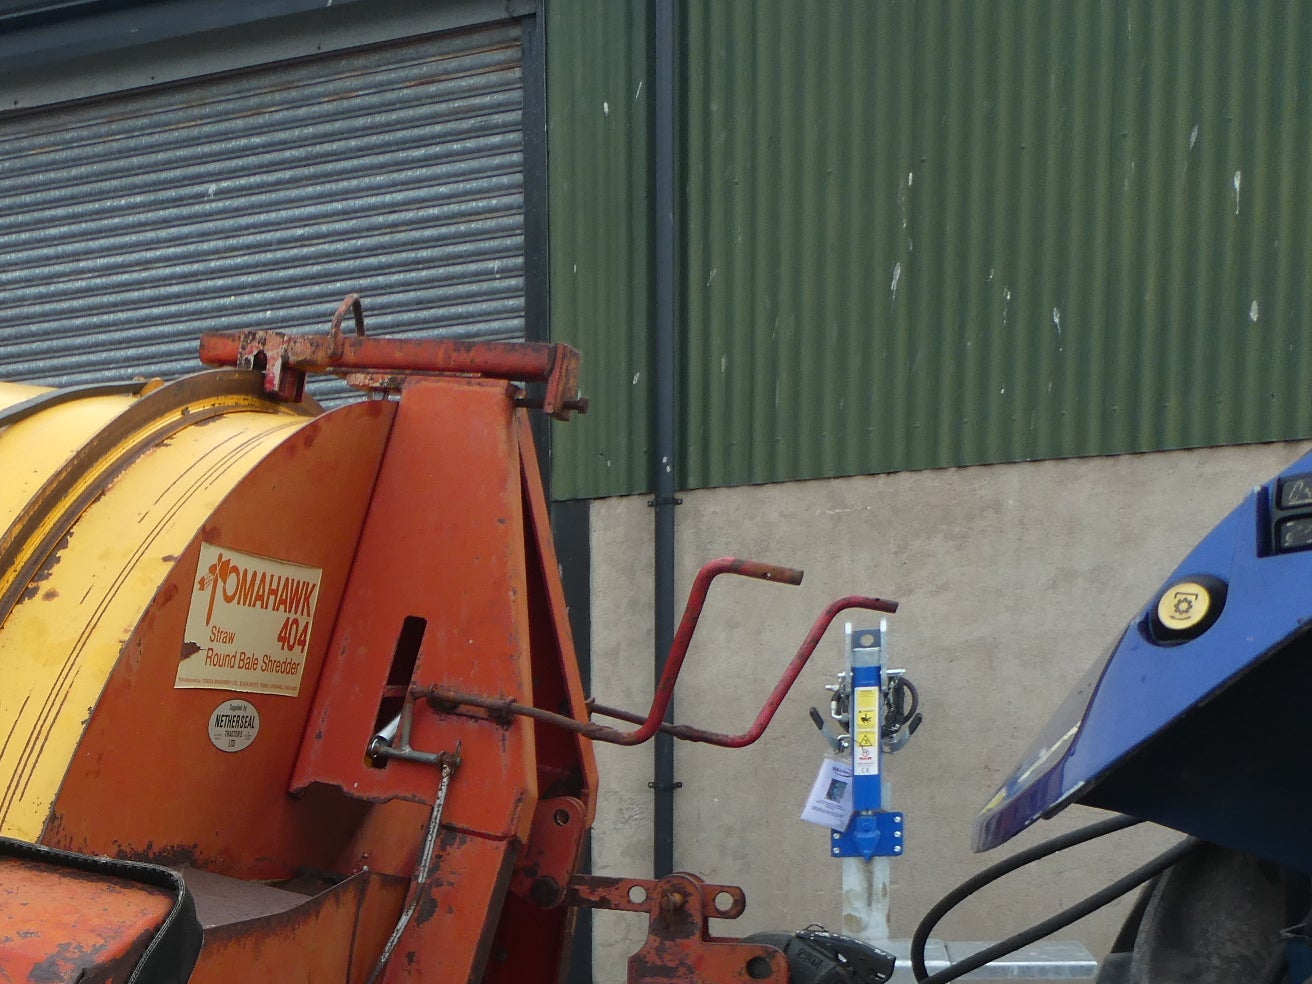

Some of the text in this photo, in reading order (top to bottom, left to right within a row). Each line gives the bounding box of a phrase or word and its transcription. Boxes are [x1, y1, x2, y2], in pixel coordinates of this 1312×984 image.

[198, 553, 317, 626] TOMAHAWK
[209, 625, 236, 645] Straw
[277, 617, 309, 654] 404
[205, 647, 300, 675] Round Bale Shredder
[214, 714, 255, 729] NETHERSEAL
[224, 730, 243, 738] TRACTORS
